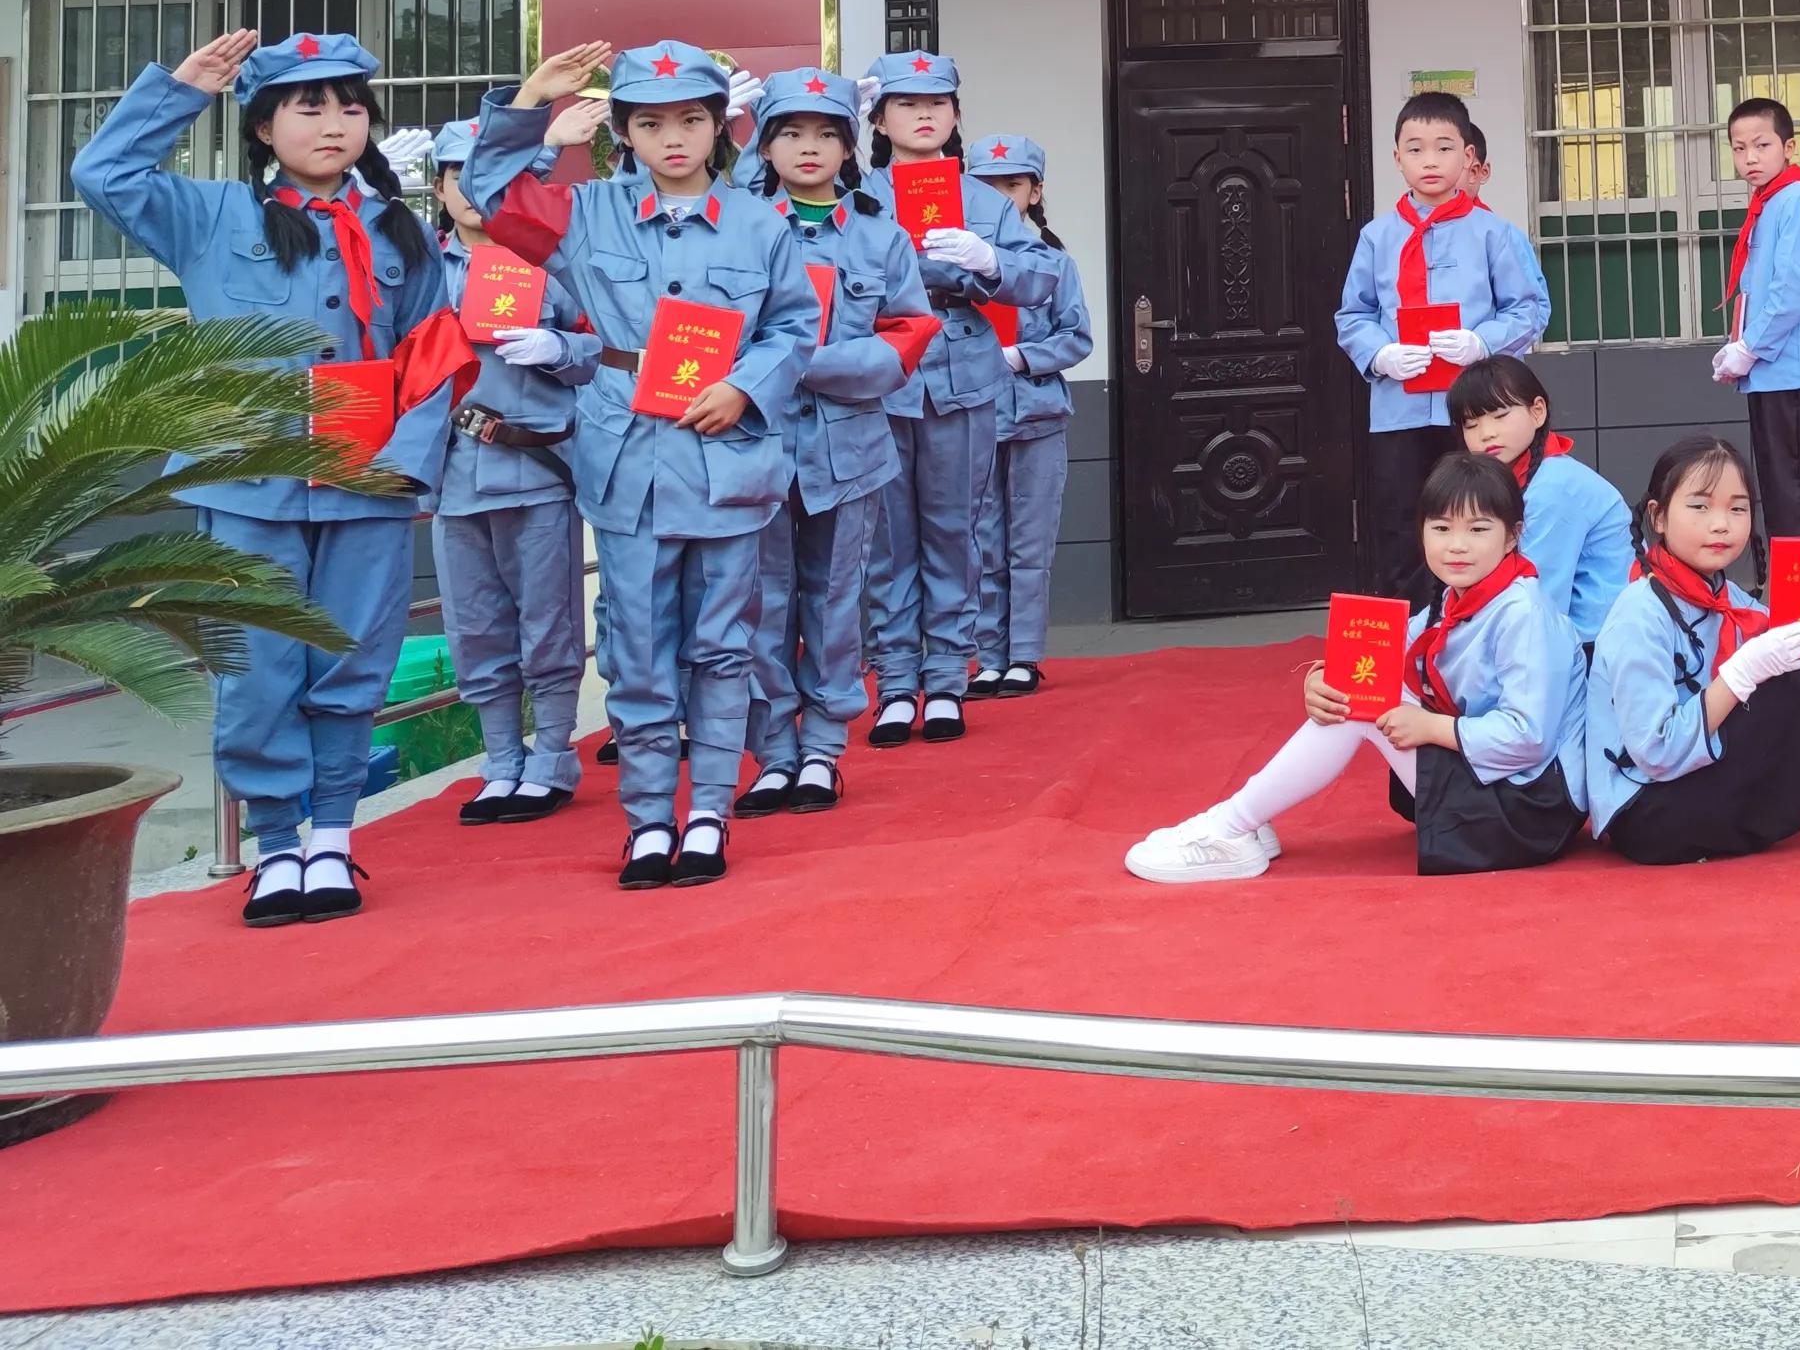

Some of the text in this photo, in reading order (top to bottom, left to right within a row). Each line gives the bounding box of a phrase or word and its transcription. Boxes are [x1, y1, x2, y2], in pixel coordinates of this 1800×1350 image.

[920, 202, 942, 225] 奖
[489, 293, 517, 318] 奖
[671, 358, 701, 388] 奖
[1351, 655, 1378, 685] 奖
